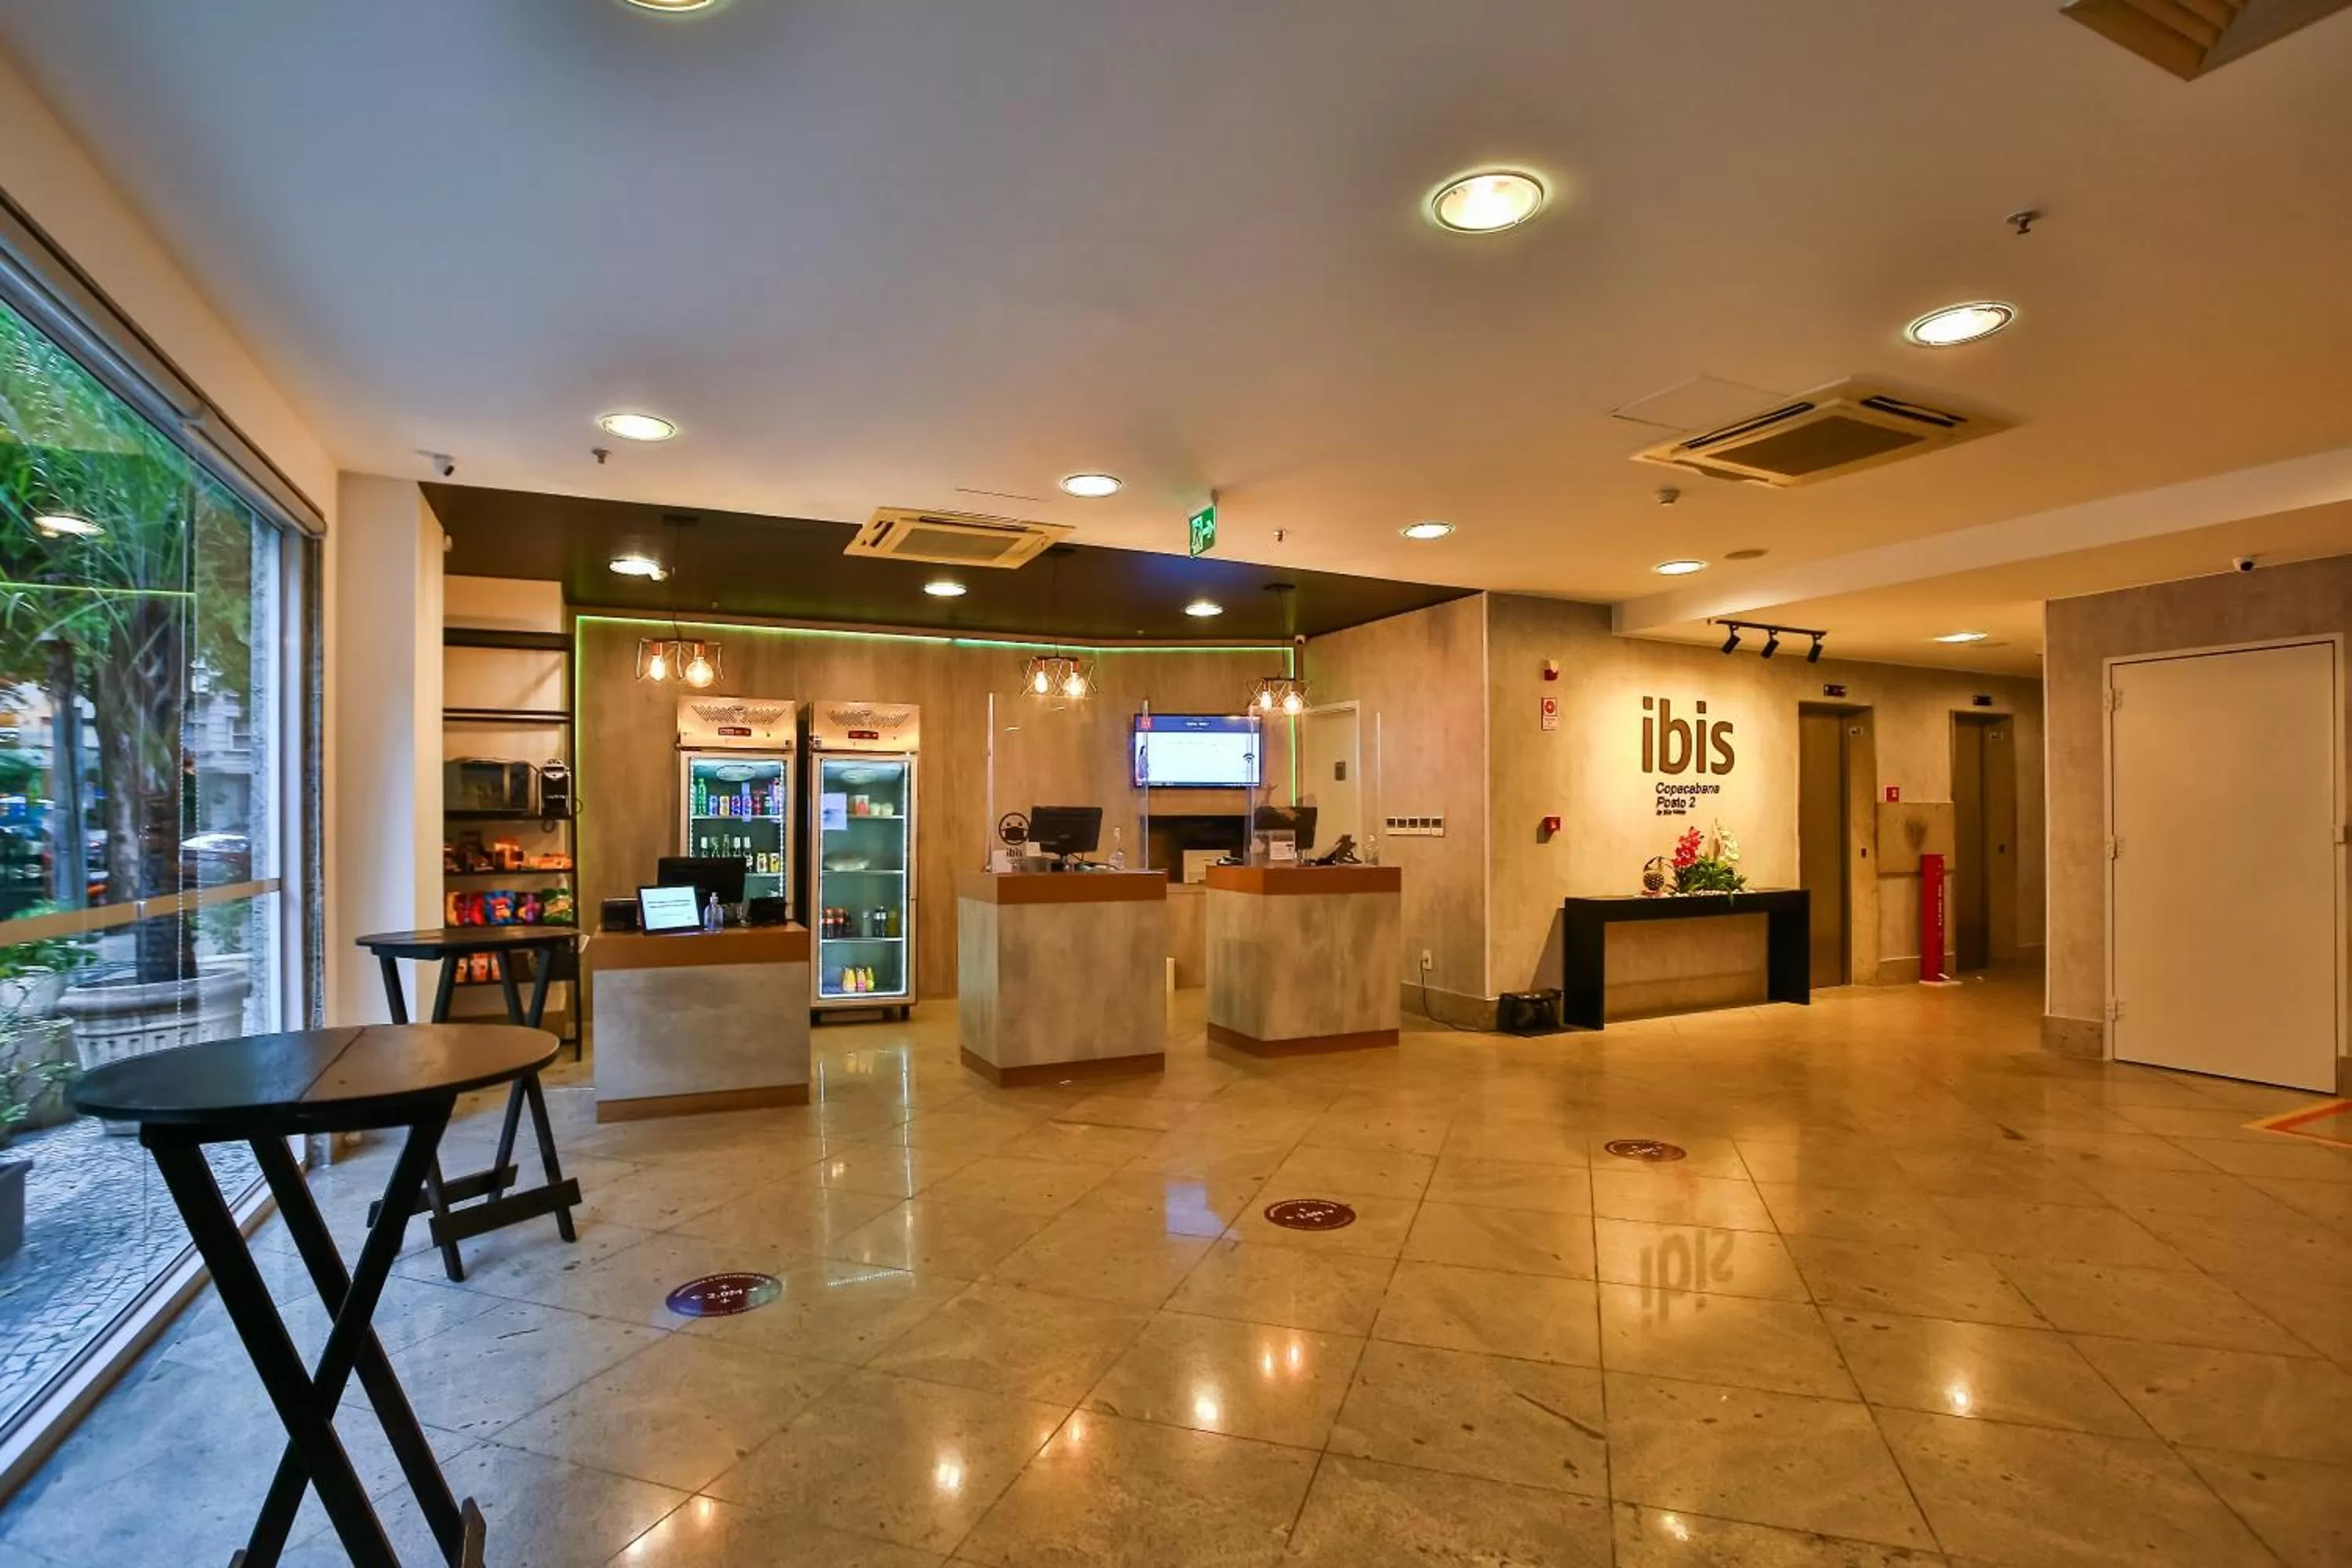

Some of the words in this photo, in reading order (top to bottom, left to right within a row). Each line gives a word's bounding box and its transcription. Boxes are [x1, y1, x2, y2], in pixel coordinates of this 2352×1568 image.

[1642, 695, 1735, 775] ibis
[1655, 782, 1720, 797] Copacabana
[1656, 796, 1686, 808] Posto
[1688, 796, 1696, 808] 2
